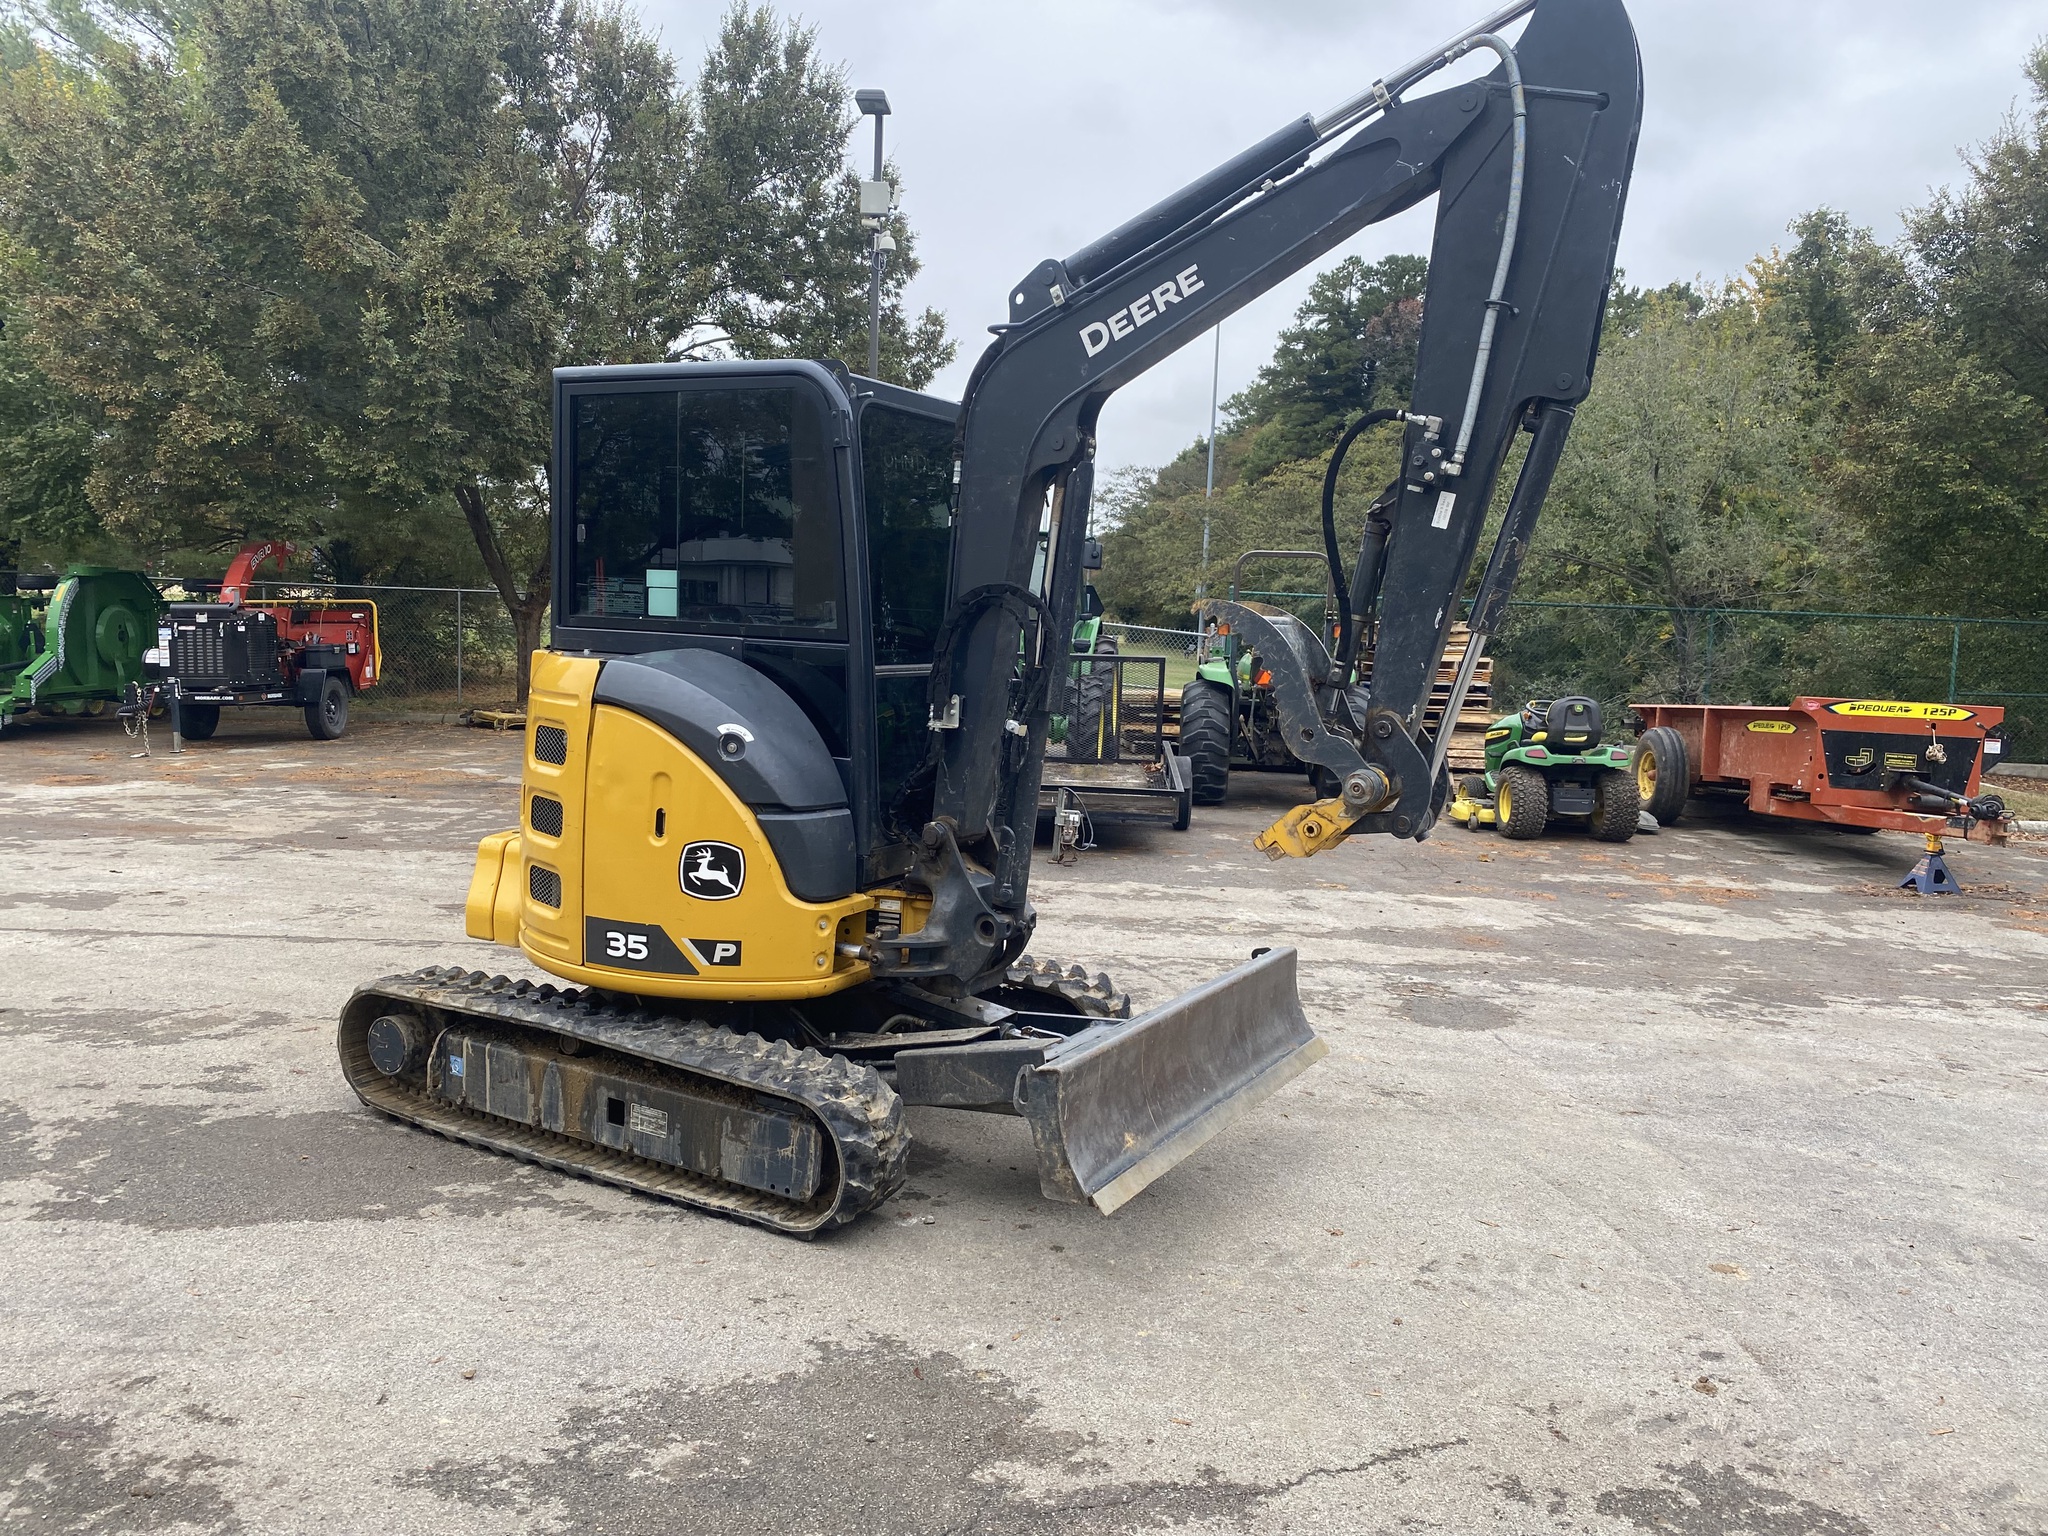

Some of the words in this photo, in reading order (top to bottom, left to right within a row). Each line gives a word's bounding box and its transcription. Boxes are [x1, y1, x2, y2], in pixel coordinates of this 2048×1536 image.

[1078, 263, 1206, 358] DEERE
[1856, 704, 1905, 714] PEQUEA
[1923, 707, 1957, 716] 125P
[606, 931, 649, 960] 35
[712, 943, 737, 963] P
